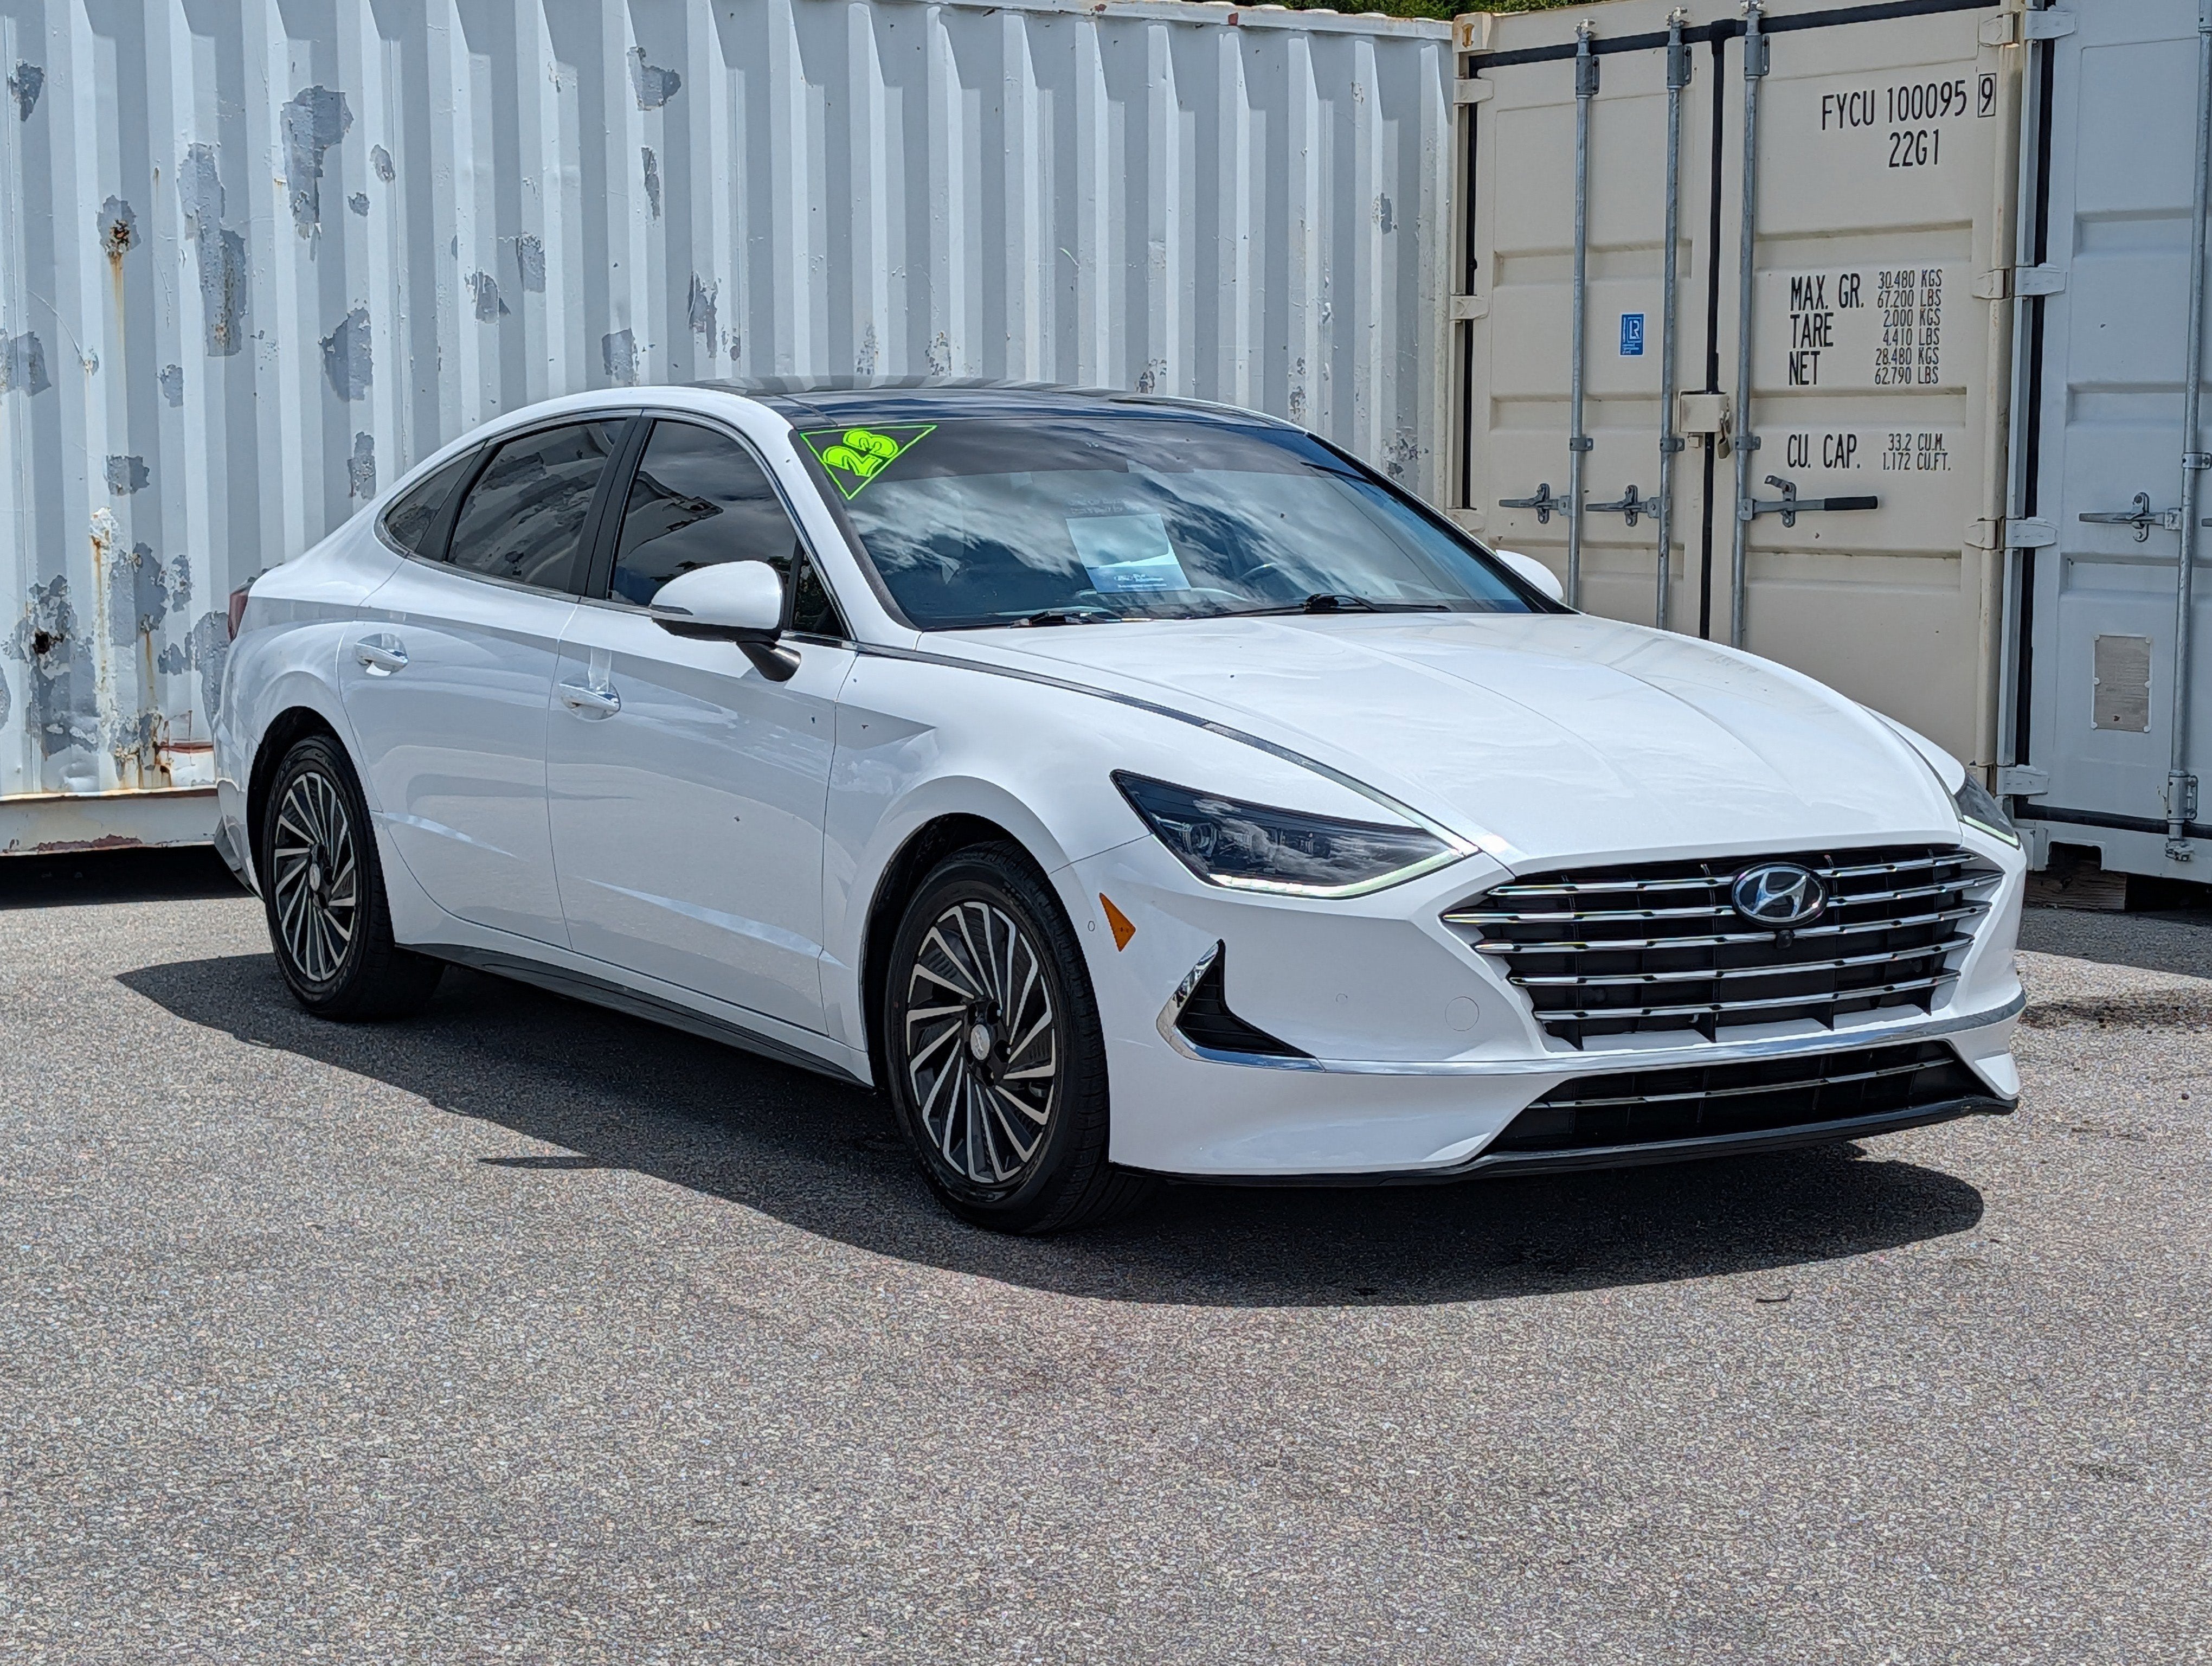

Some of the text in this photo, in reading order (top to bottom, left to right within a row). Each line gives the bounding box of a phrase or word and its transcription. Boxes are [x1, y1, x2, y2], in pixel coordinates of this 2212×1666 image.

[1822, 75, 1996, 131] FYCU 100095 9
[1888, 129, 1939, 168] 22G1
[1920, 269, 1943, 287] KGS
[1790, 273, 1864, 311] MAX. GR.
[1877, 288, 1941, 309] 67.200 LBS
[1919, 307, 1941, 326] KGS
[1790, 312, 1834, 349] TARE
[1918, 327, 1940, 346] LBS
[1875, 347, 1939, 366] 28.480 KGS
[1789, 350, 1821, 386] NET
[1874, 366, 1939, 385] 62.790 LBS
[822, 428, 898, 477] 23
[1787, 433, 1861, 469] CU. CAP.
[1887, 433, 1912, 452] 33.2
[1882, 452, 1911, 471] 1.172
